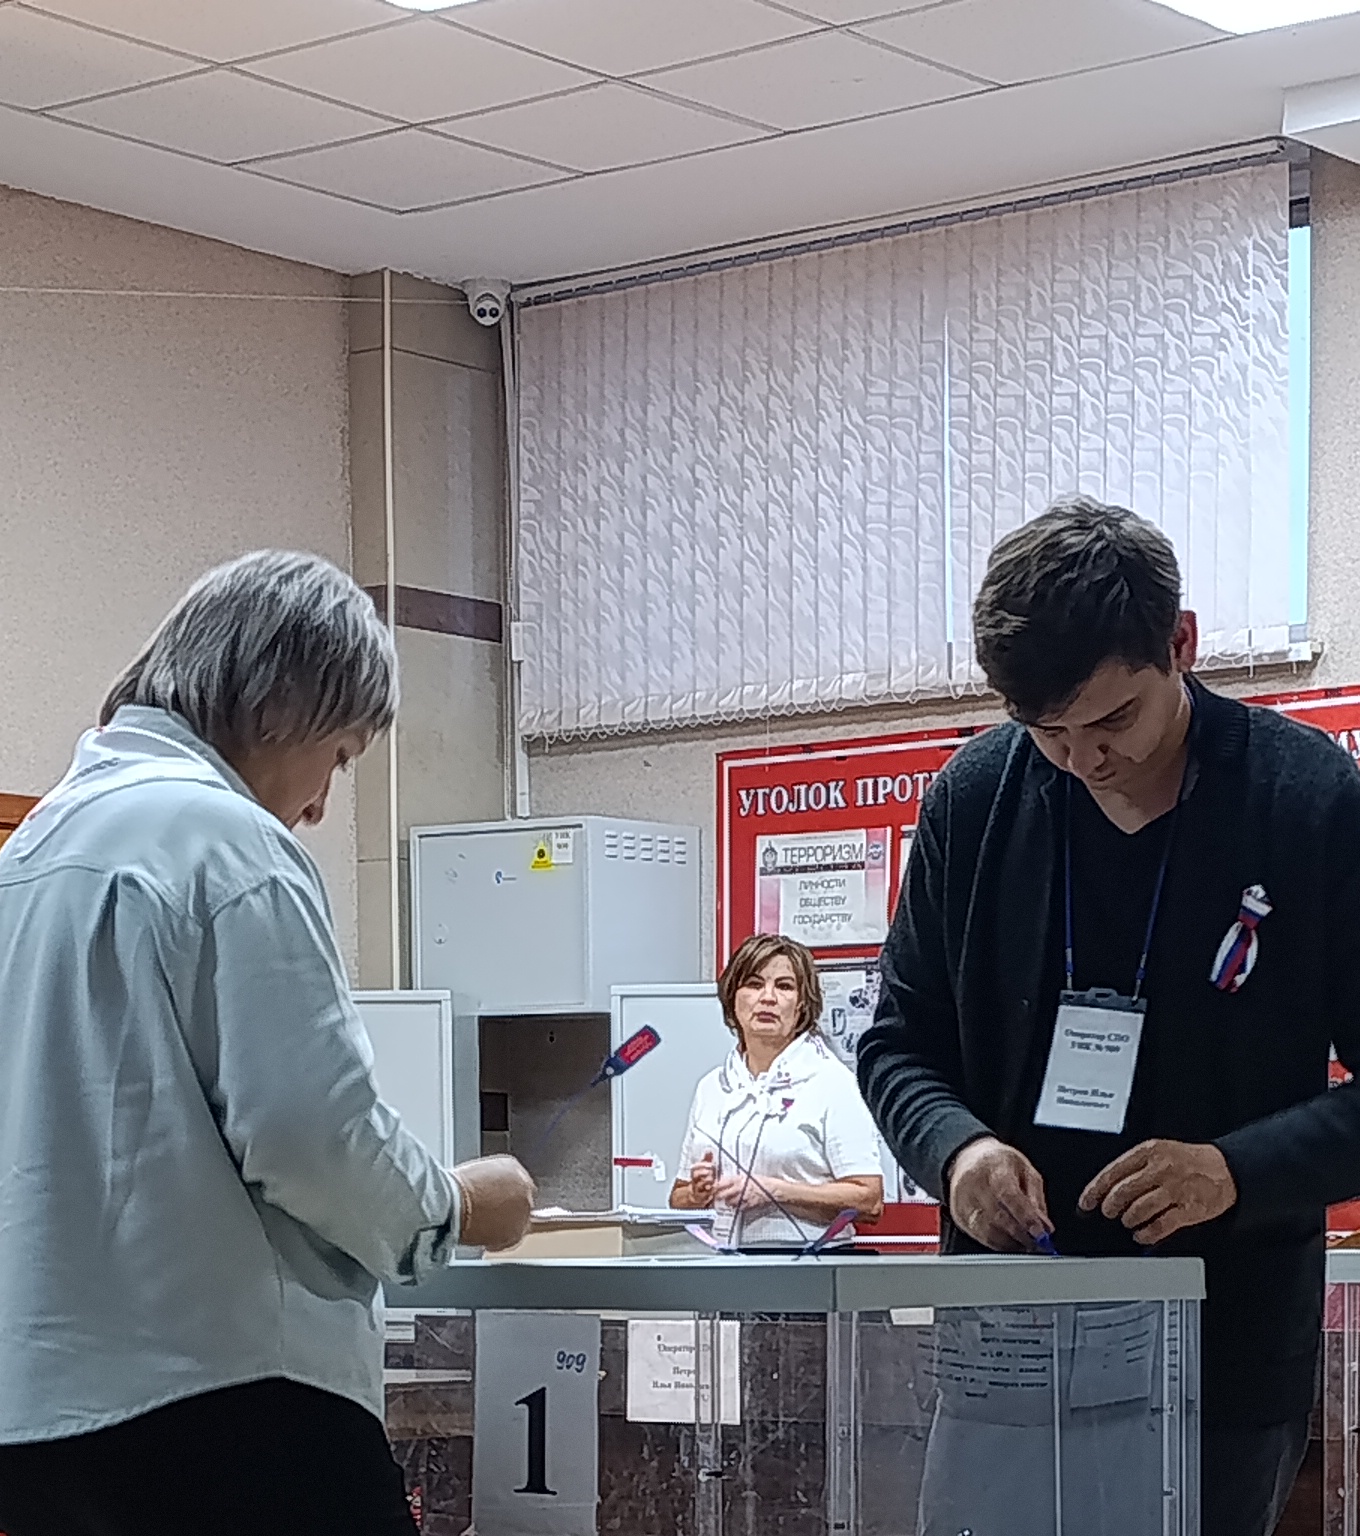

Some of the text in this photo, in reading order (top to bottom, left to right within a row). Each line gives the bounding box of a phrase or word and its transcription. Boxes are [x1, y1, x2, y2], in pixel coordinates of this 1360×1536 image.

[738, 779, 847, 817] УГОЛОК
[782, 843, 865, 865] ТЕРРОРИЗМ
[799, 895, 847, 908] ОБЩЕСТВУ
[556, 1350, 587, 1373] 909
[513, 1386, 558, 1496] 1
